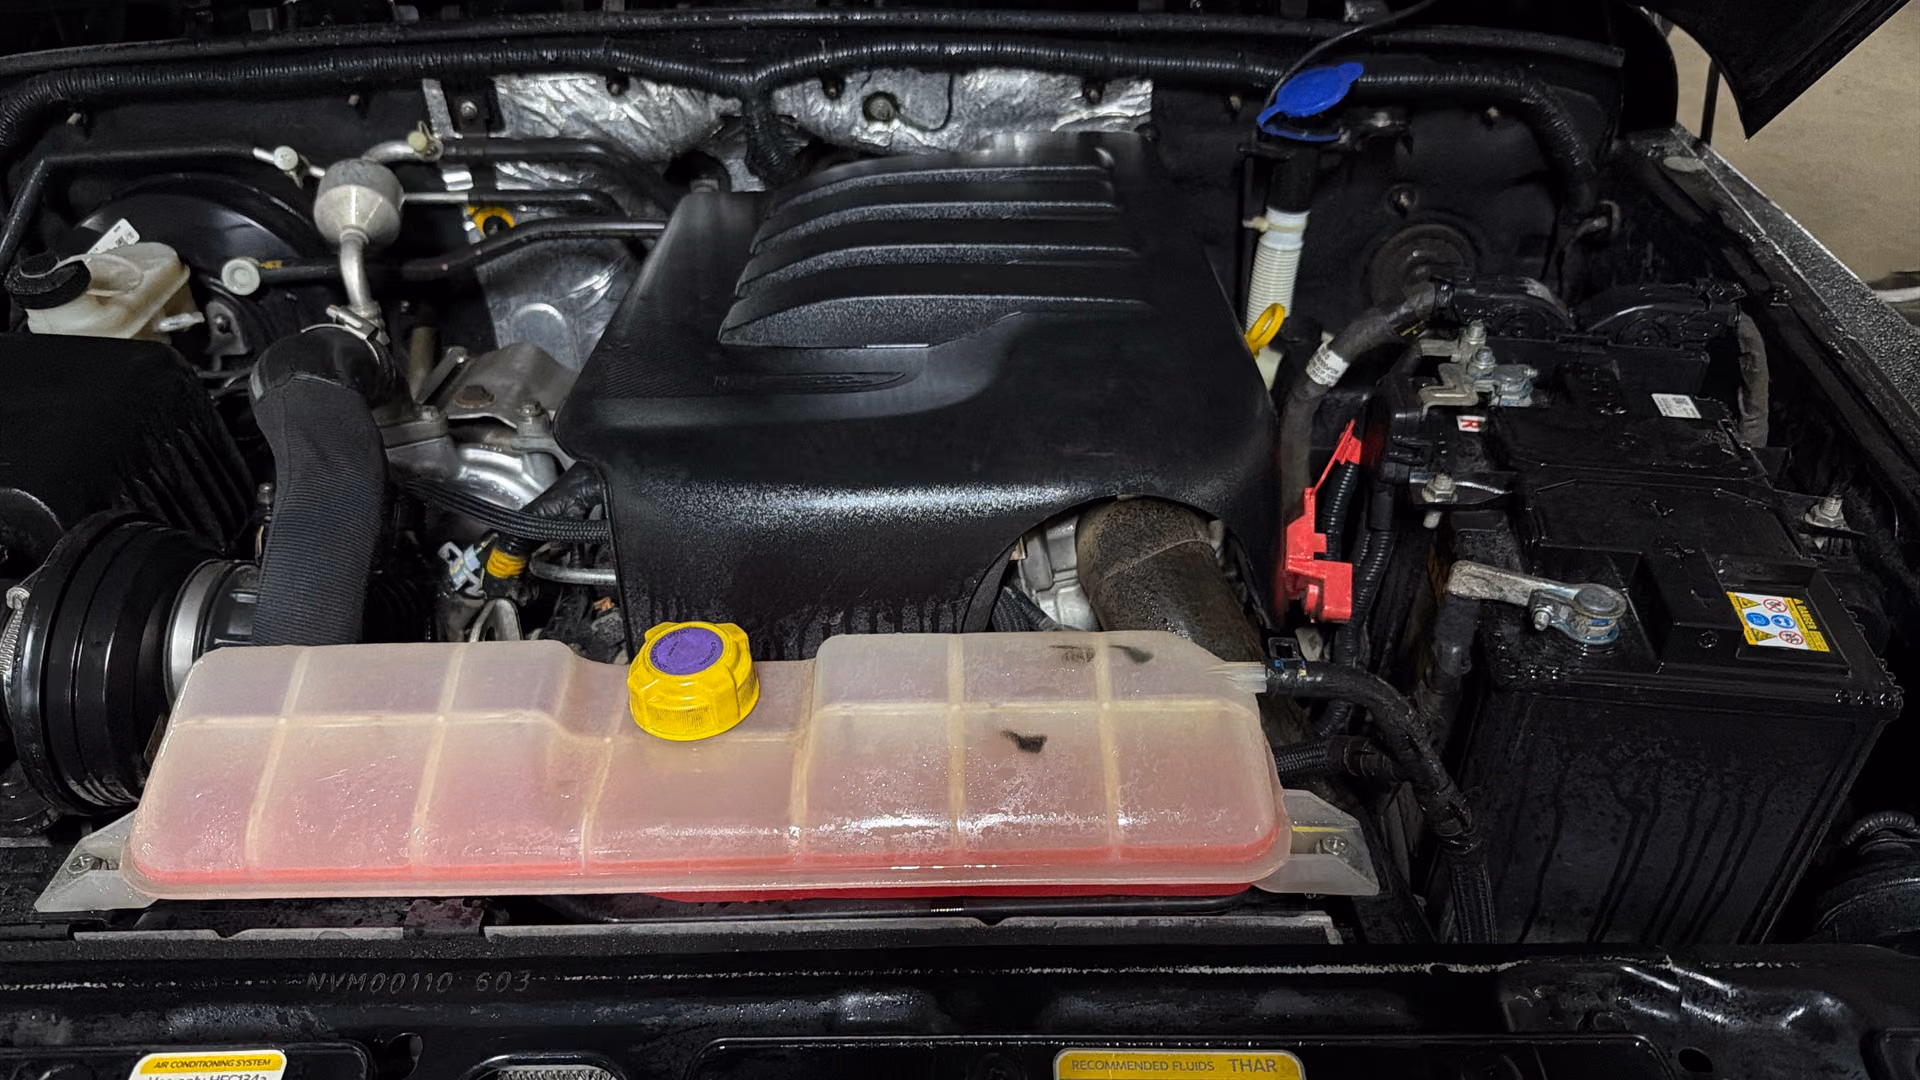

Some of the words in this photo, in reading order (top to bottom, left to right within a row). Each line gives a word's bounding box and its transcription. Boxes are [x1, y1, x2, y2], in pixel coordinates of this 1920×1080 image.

[476, 971, 531, 992] 603
[154, 1060, 170, 1069] AIR
[170, 1059, 235, 1069] CONDITIONING
[235, 1058, 272, 1067] SYSTEM
[1071, 1060, 1168, 1071] RECOMMENDED
[1172, 1060, 1215, 1072] FLUIDS
[1227, 1058, 1277, 1073] THAR
